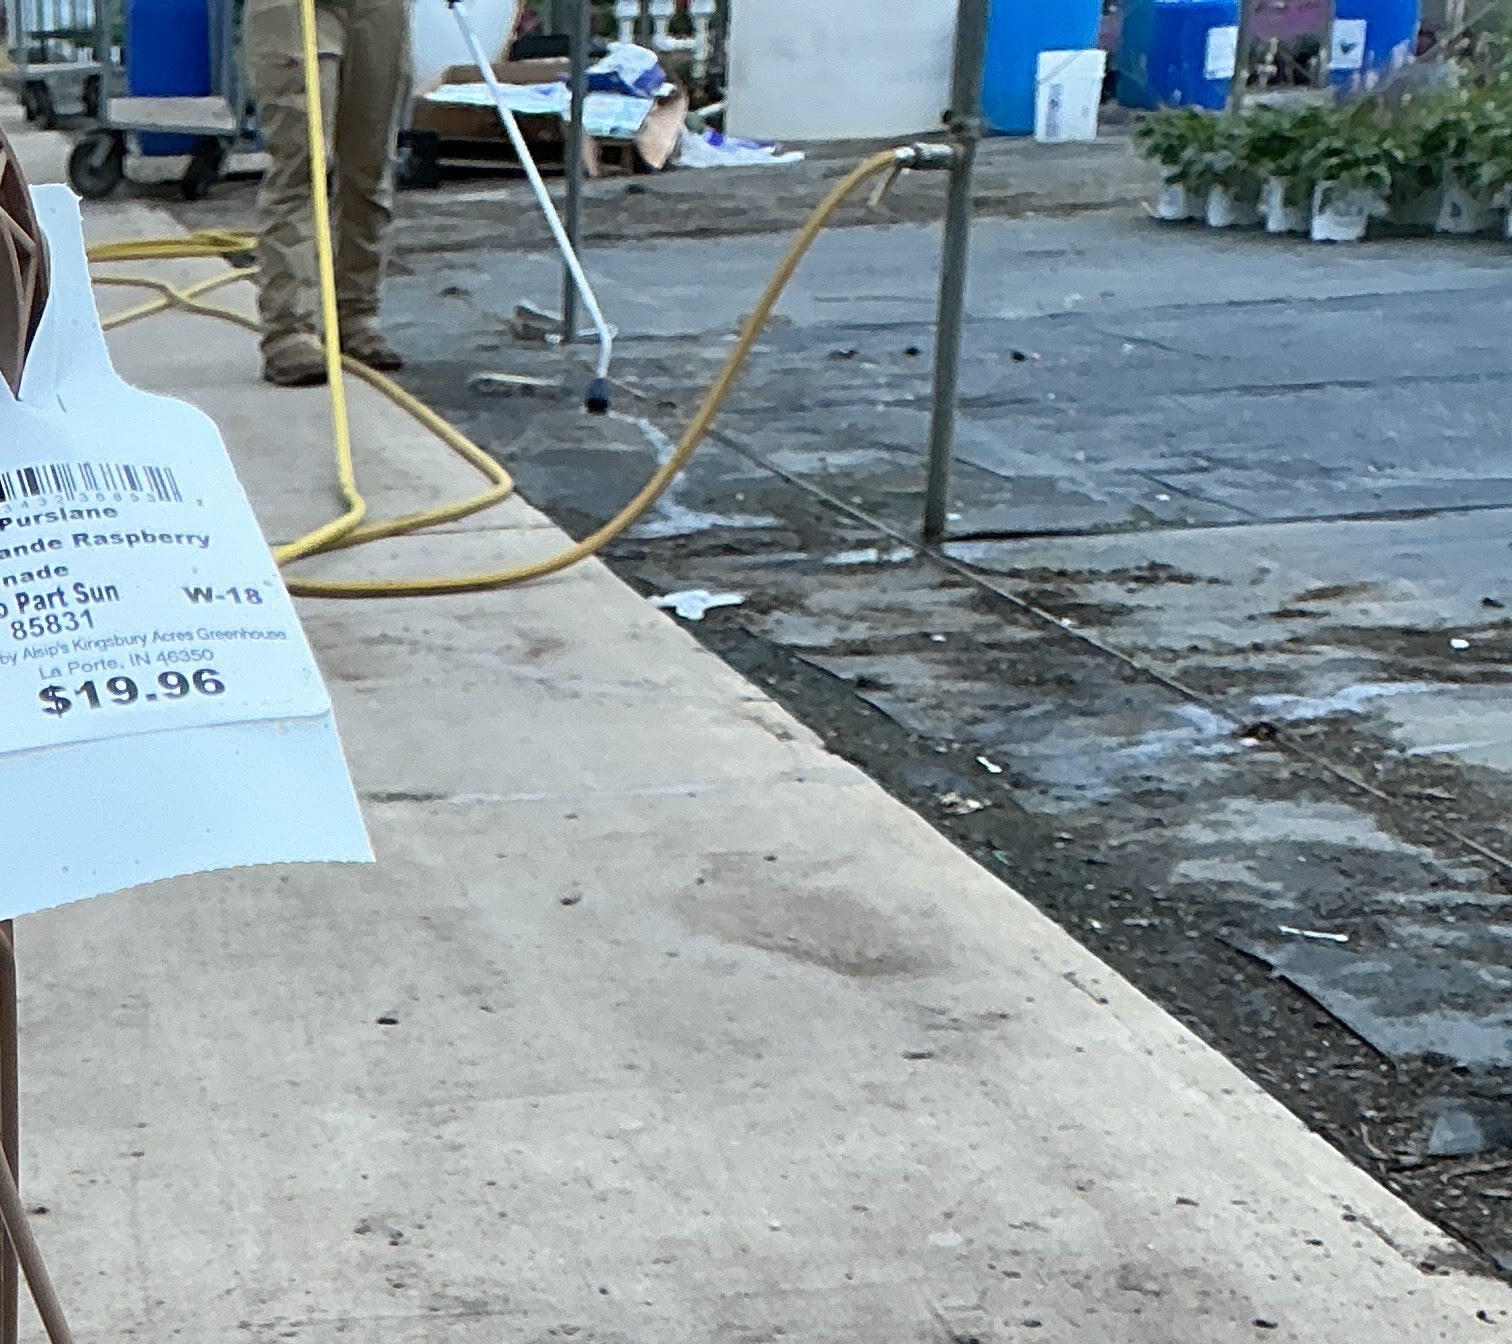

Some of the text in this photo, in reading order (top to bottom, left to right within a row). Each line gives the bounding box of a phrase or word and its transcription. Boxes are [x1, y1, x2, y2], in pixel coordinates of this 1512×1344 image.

[72, 529, 210, 549] Raspberry
[15, 585, 68, 615] Part
[72, 582, 120, 605] Sun
[182, 586, 264, 605] W-18
[11, 608, 95, 640] 85831
[0, 652, 18, 666] by
[23, 642, 70, 661] Alsip's
[72, 633, 148, 652] Kingsbury
[152, 630, 194, 643] Acres
[196, 627, 287, 642] Greenhouse
[38, 649, 214, 680] La Porte, IN 46350
[38, 668, 226, 718] $19.96
